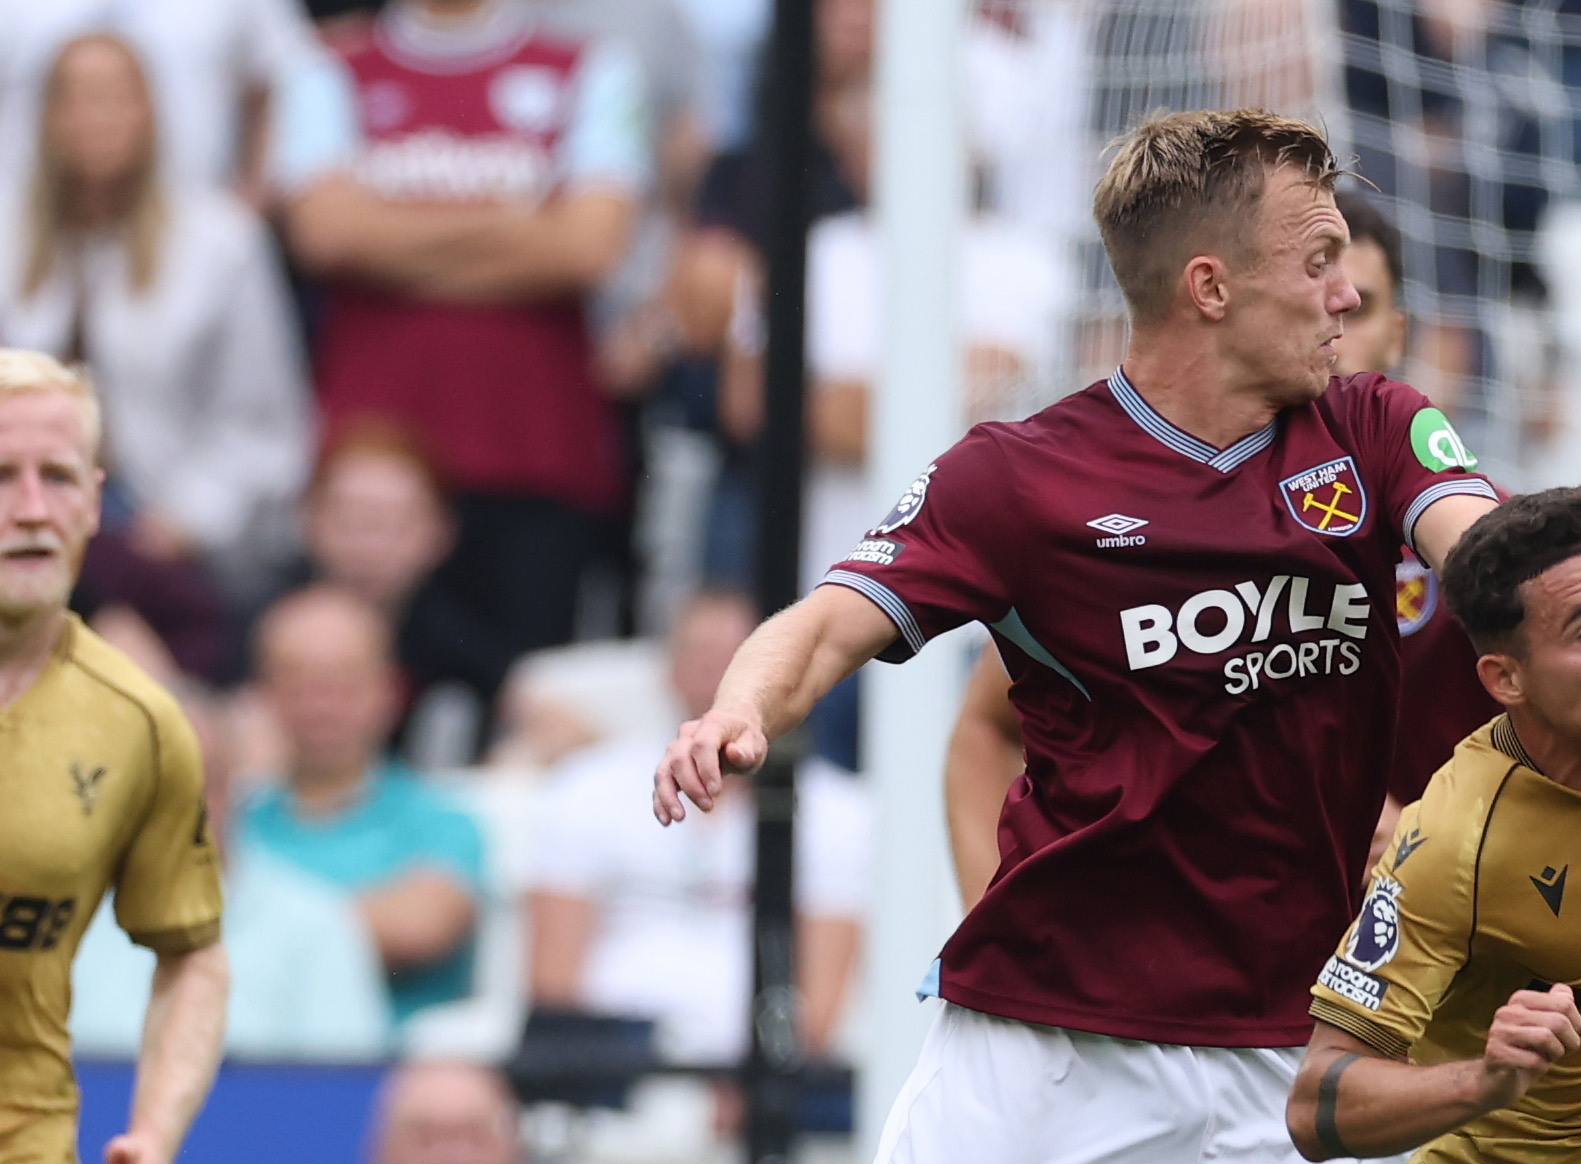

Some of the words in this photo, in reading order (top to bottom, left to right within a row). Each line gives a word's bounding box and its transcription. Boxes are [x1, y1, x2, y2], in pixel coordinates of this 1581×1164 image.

[1287, 471, 1318, 492] WEST
[1318, 461, 1347, 481] HAM
[1302, 473, 1337, 492] UNITED
[1096, 534, 1146, 548] umbro
[1119, 575, 1371, 671] BOYLE
[1223, 638, 1361, 695] SPORTS
[1328, 978, 1380, 1012] racism
[1335, 962, 1380, 996] room
